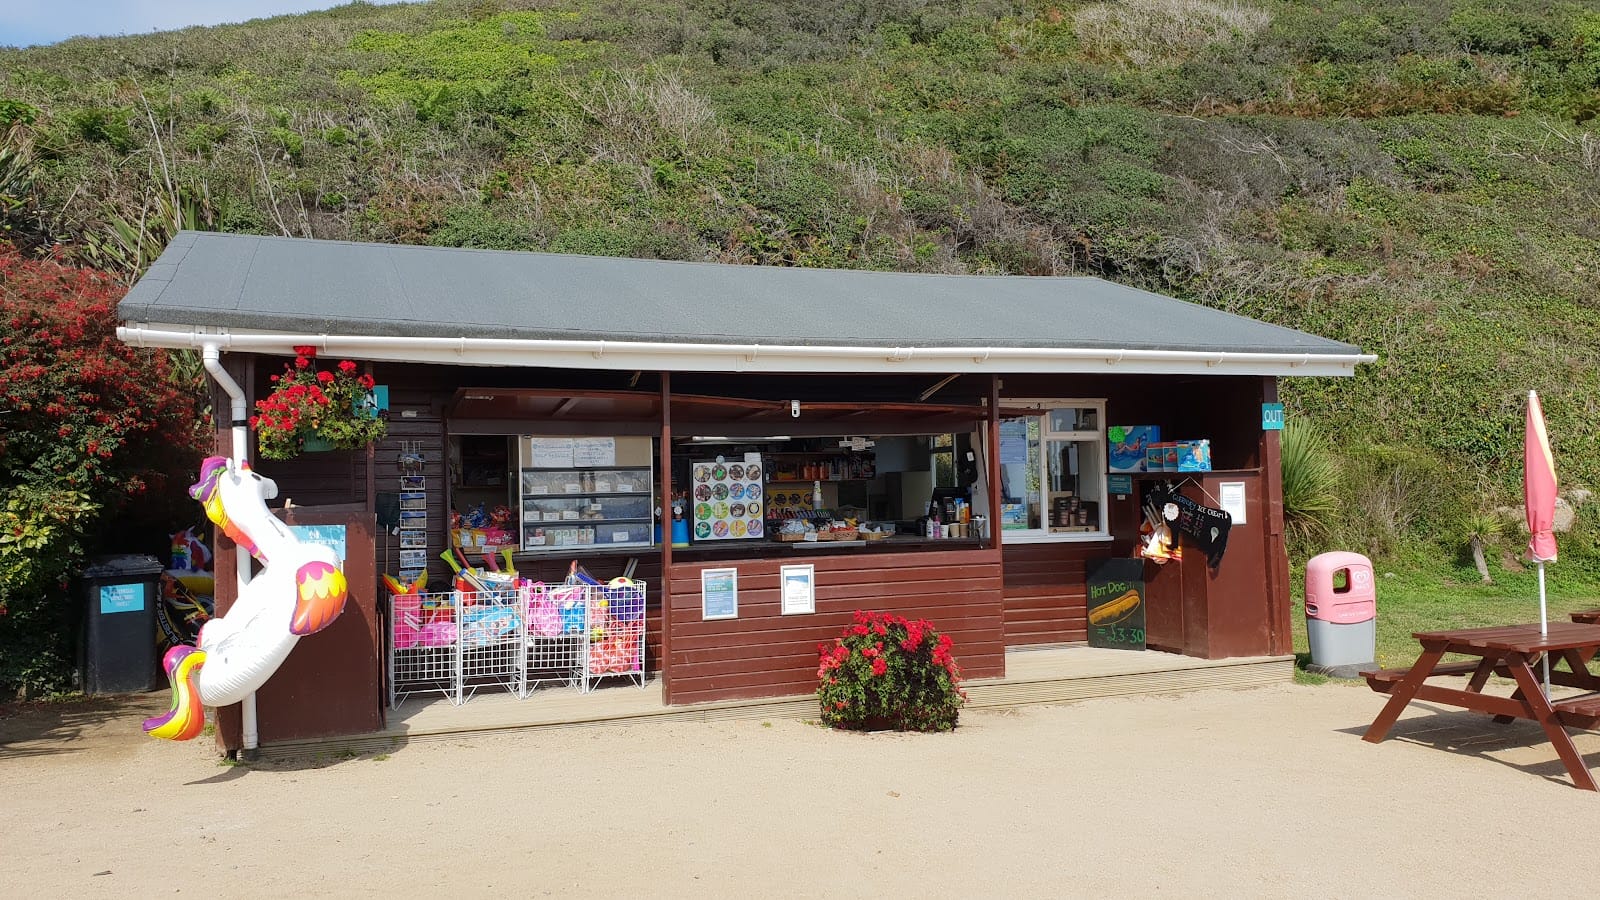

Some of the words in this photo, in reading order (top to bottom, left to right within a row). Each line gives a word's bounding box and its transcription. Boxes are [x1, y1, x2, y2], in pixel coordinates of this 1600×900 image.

[1264, 409, 1282, 423] OUT
[1197, 505, 1206, 514] ICE
[1090, 585, 1107, 599] HOT
